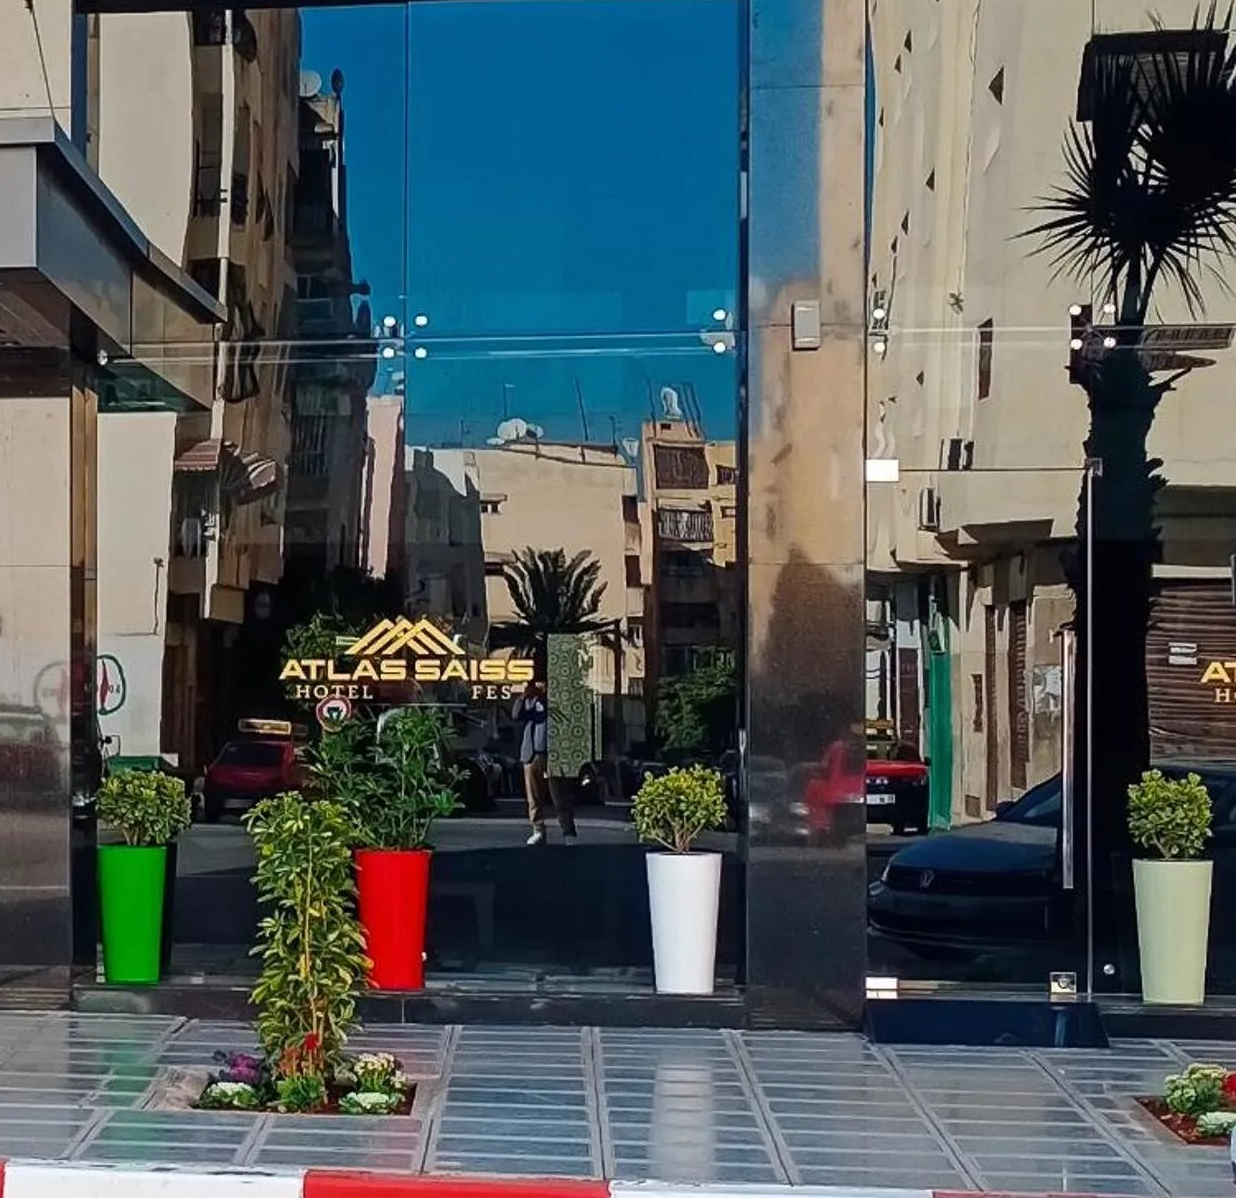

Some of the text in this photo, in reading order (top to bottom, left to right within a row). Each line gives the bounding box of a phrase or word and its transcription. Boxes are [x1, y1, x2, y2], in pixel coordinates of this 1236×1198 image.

[278, 659, 535, 681] ATLAS SAISS
[295, 684, 512, 700] HOTEL FES
[1215, 688, 1236, 703] H
